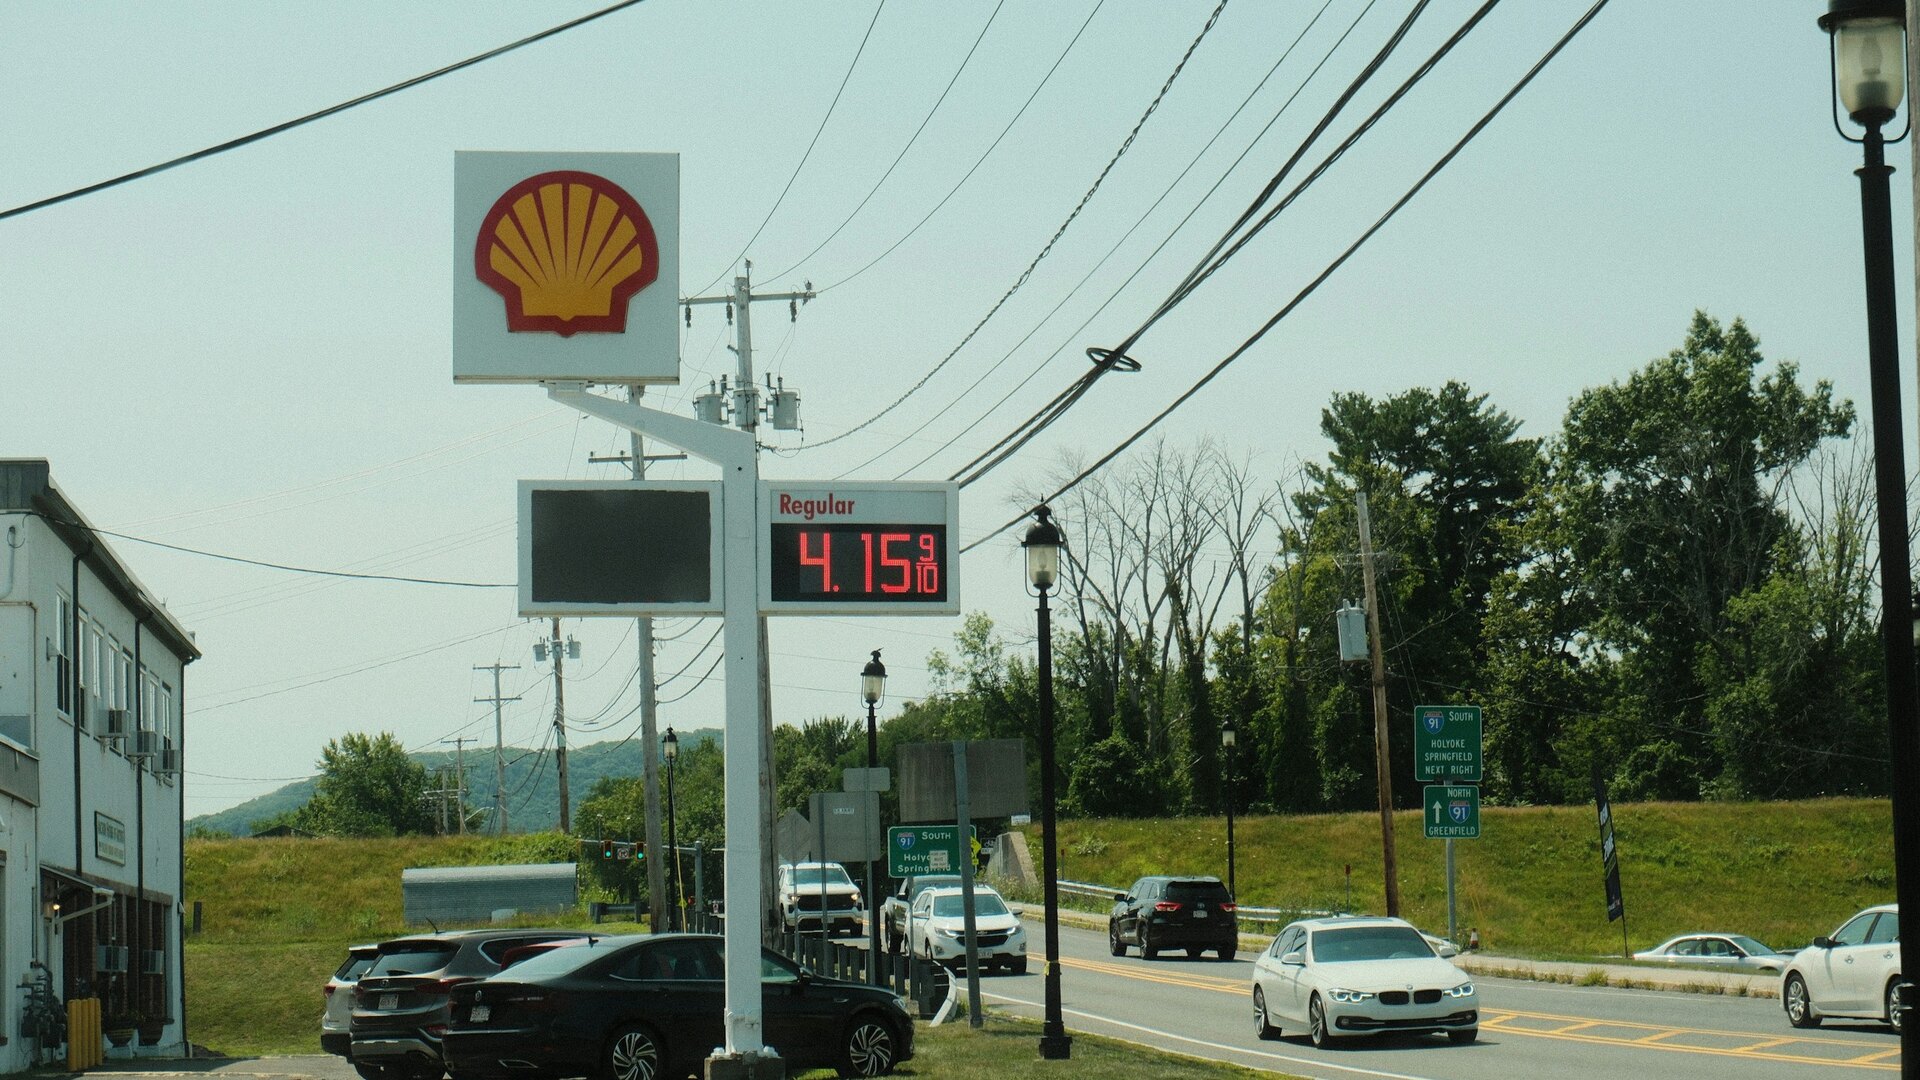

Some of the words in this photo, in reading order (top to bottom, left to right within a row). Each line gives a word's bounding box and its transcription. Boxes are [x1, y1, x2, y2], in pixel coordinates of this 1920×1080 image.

[780, 493, 855, 520] Regular
[1449, 711, 1473, 721] SOUTH
[1429, 719, 1438, 729] 91
[1431, 739, 1465, 748] HOLYOKE
[1425, 752, 1472, 761] SPRINGFIELD
[1425, 766, 1444, 774] NEXT
[1451, 766, 1473, 774] RIGHT
[1448, 788, 1471, 798] NORTH
[1453, 807, 1466, 820] 91
[1429, 826, 1475, 836] GREENFIELD
[900, 838, 910, 846] 91
[898, 864, 951, 873] Springd
